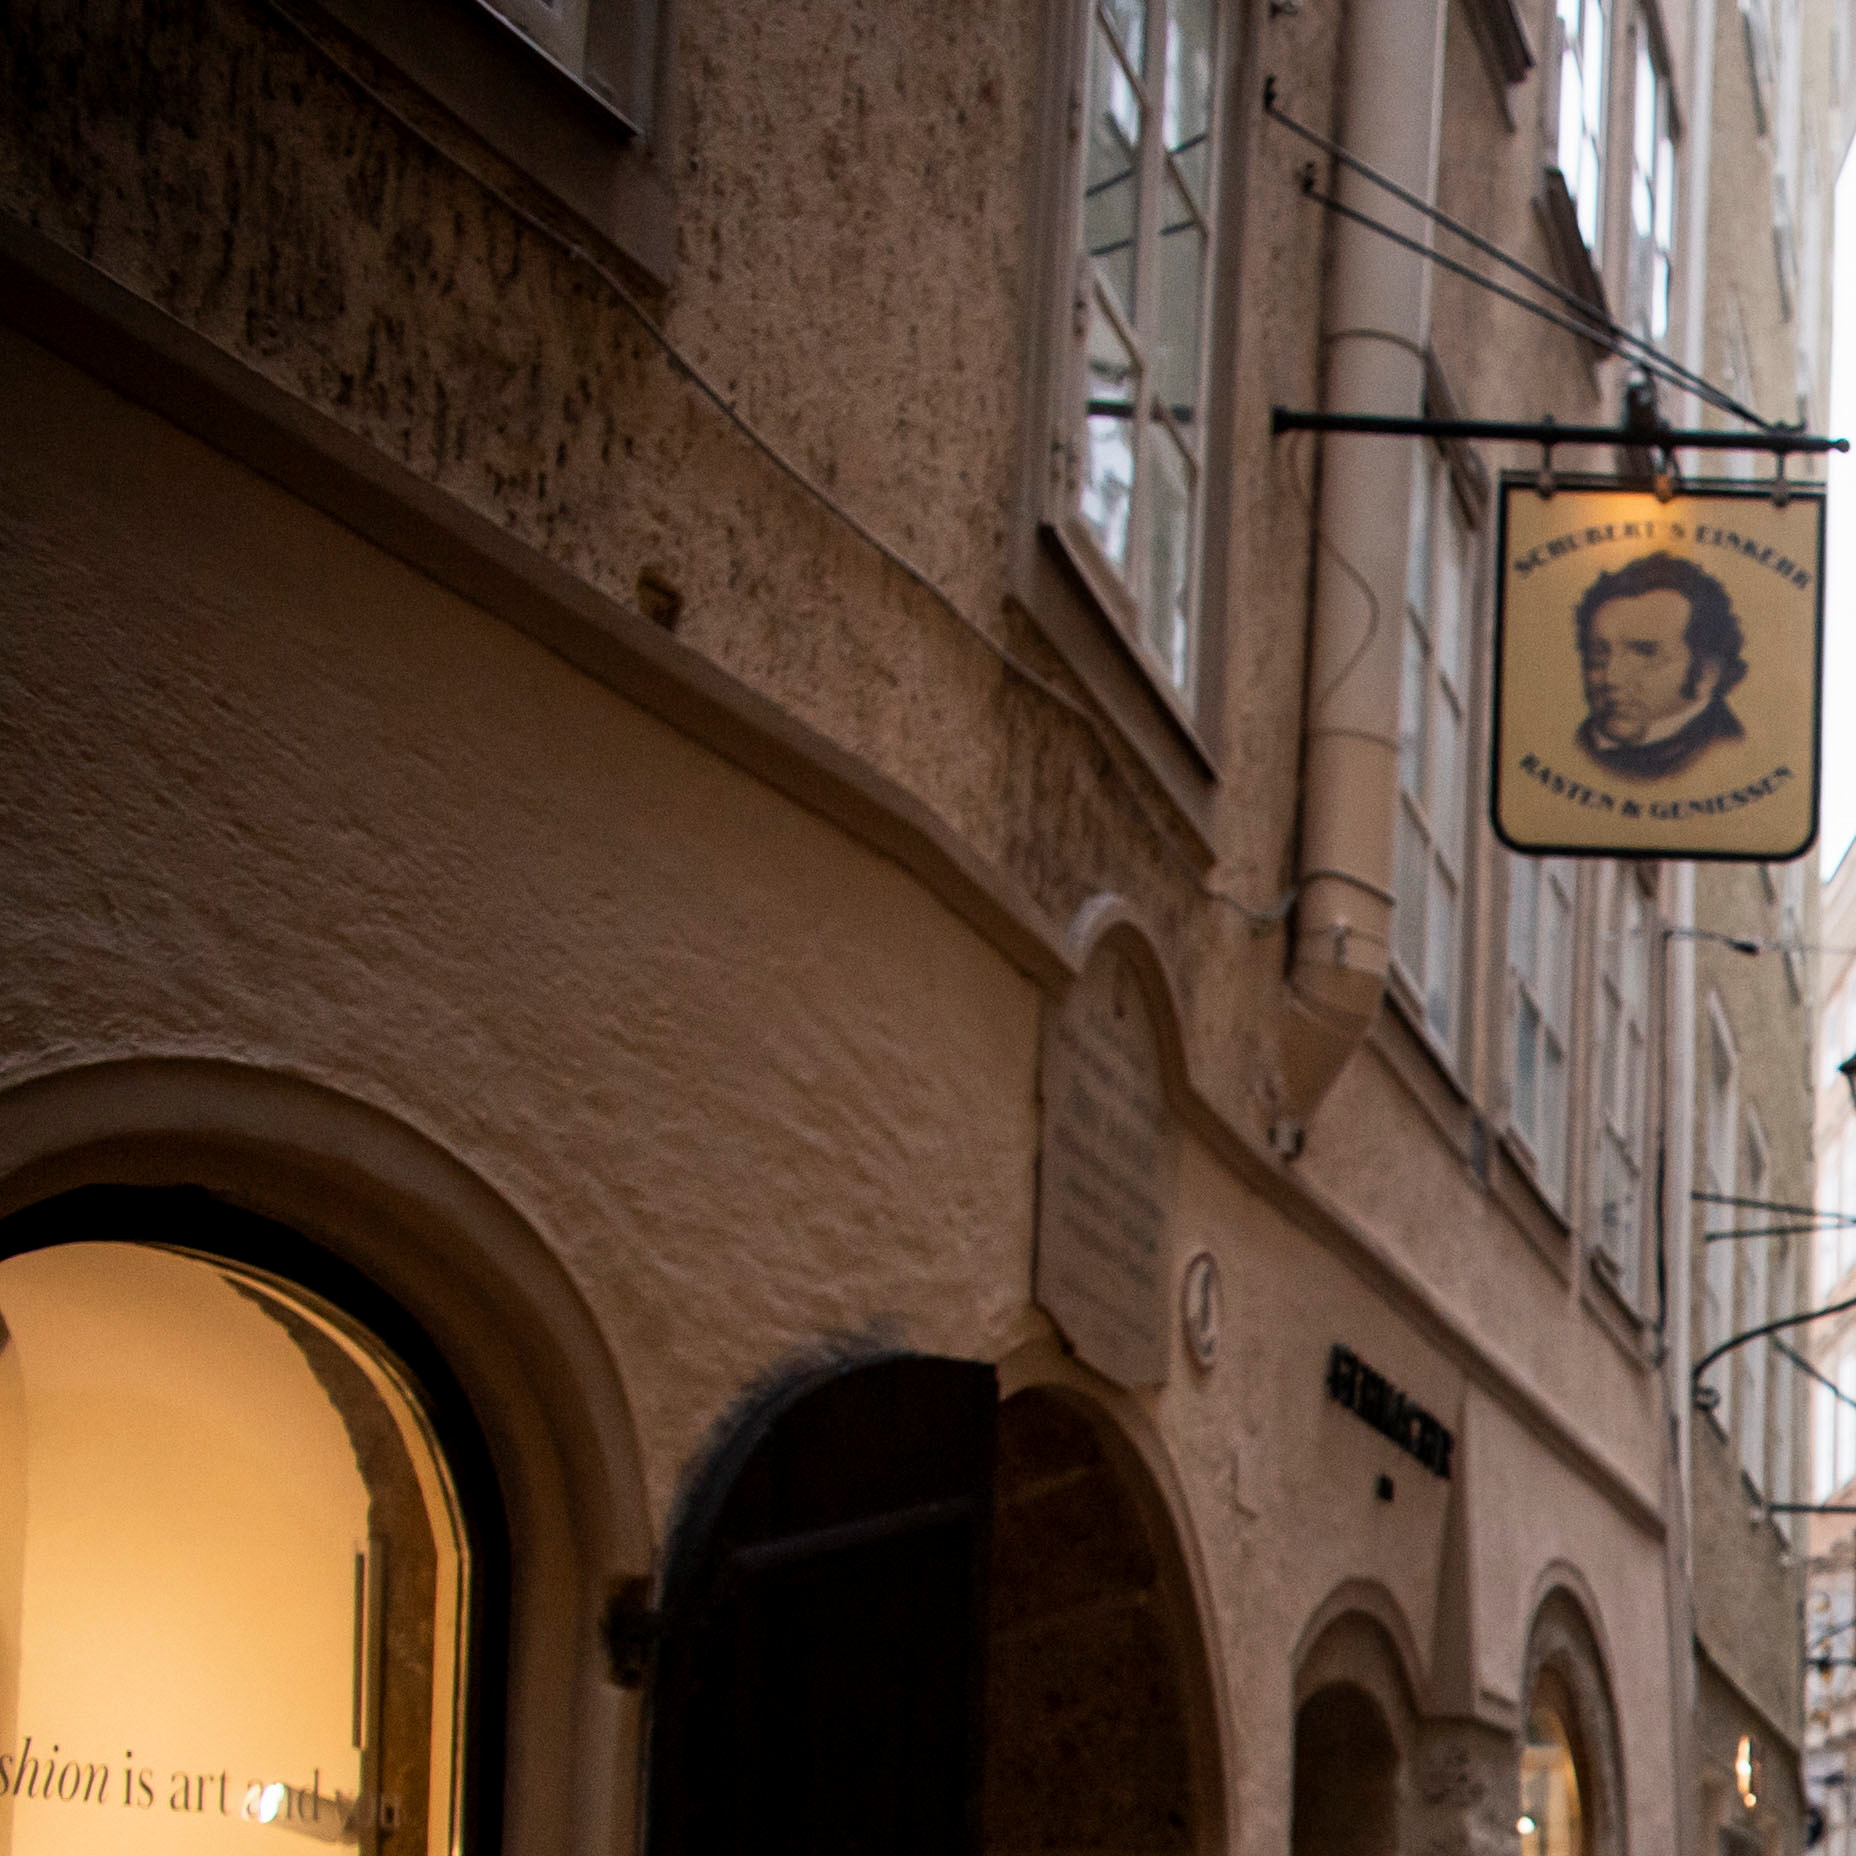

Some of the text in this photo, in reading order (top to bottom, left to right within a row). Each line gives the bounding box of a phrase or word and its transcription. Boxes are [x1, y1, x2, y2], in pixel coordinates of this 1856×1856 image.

[1621, 799, 1641, 819] &
[123, 1749, 154, 1810] is
[170, 1767, 231, 1815] art
